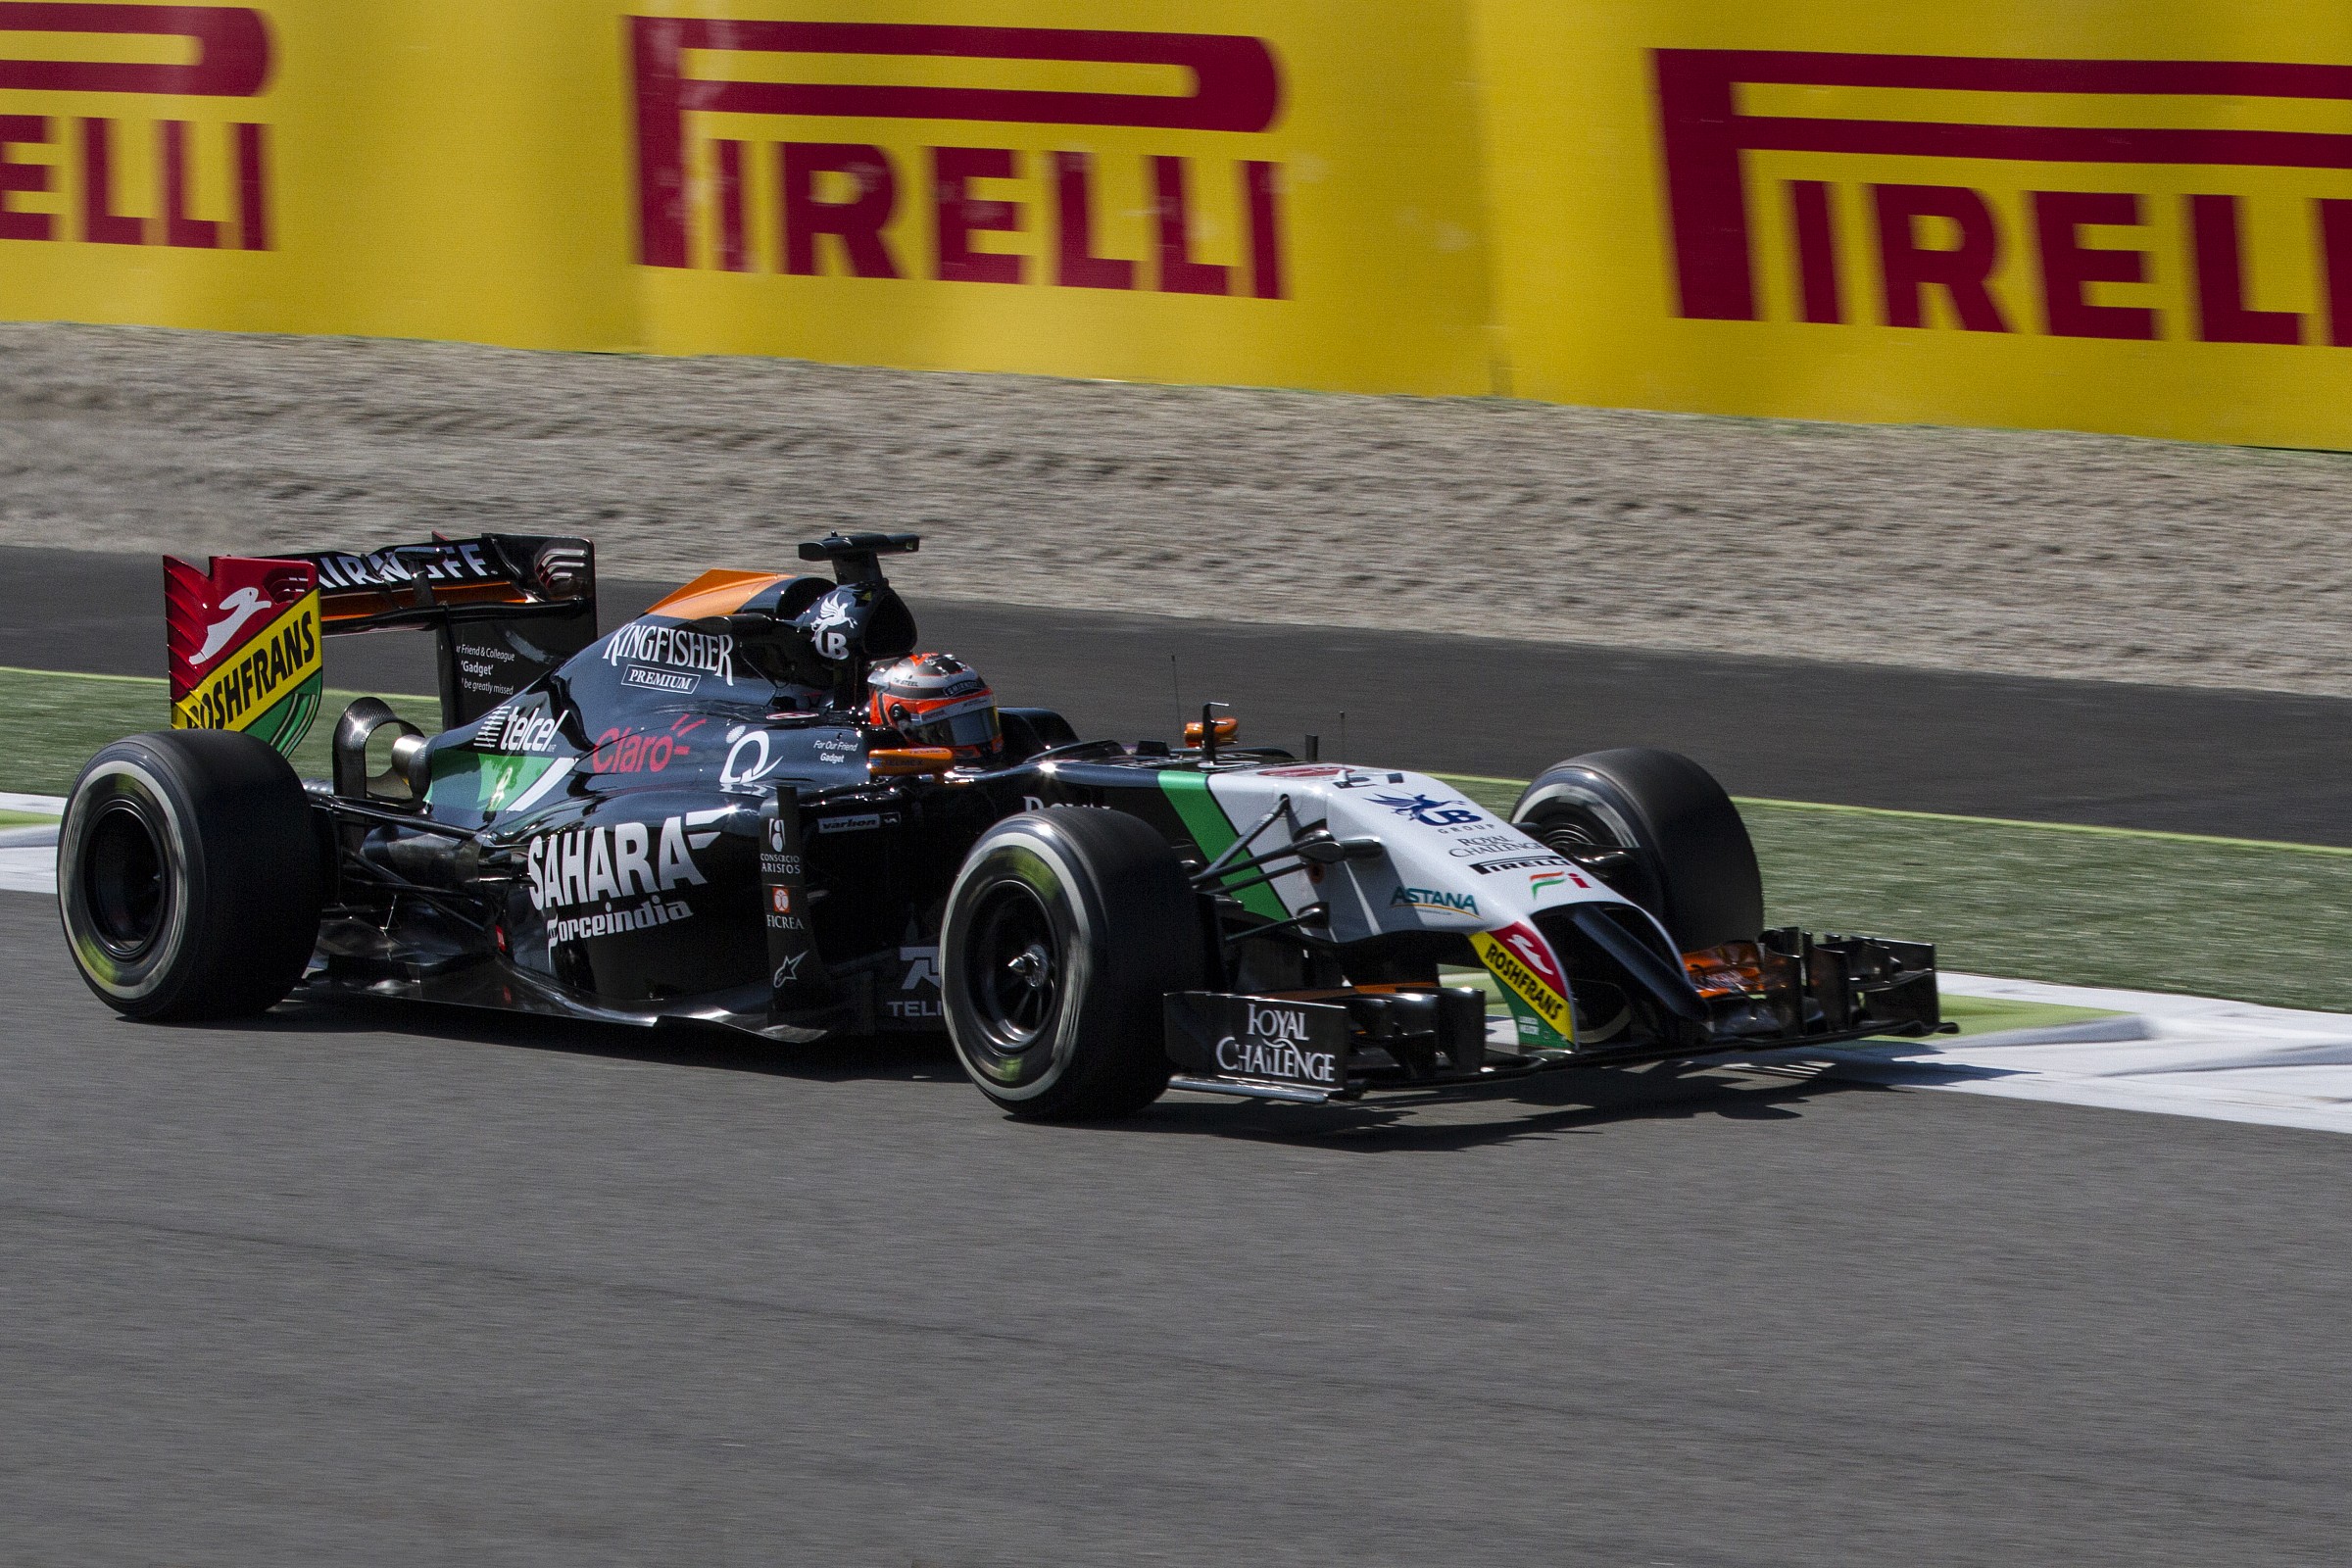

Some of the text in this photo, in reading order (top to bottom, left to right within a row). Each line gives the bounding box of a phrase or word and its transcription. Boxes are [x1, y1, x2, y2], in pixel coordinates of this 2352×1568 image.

[619, 15, 1296, 301] PIRELLI
[461, 644, 480, 656] Friend
[480, 647, 485, 657] &
[485, 648, 515, 663] Colleague
[602, 621, 734, 686] KINGFISHER
[464, 678, 472, 689] be
[472, 681, 493, 694] greatly
[493, 684, 514, 695] missed
[628, 668, 693, 690] PREMIUM
[500, 706, 569, 752] telcel
[592, 725, 674, 774] Claro
[812, 740, 858, 752] For Our Friend
[819, 753, 845, 764] Gadget
[1437, 823, 1496, 835] GROUP
[1448, 842, 1545, 858] CHALLENGE
[1456, 835, 1513, 847] ROYAL
[527, 815, 709, 911] SAHARA
[1468, 856, 1573, 876] PIRELLI
[1390, 885, 1480, 916] ASTANA
[765, 913, 805, 930] FICREA
[1484, 942, 1565, 1021] ROSHFRANS
